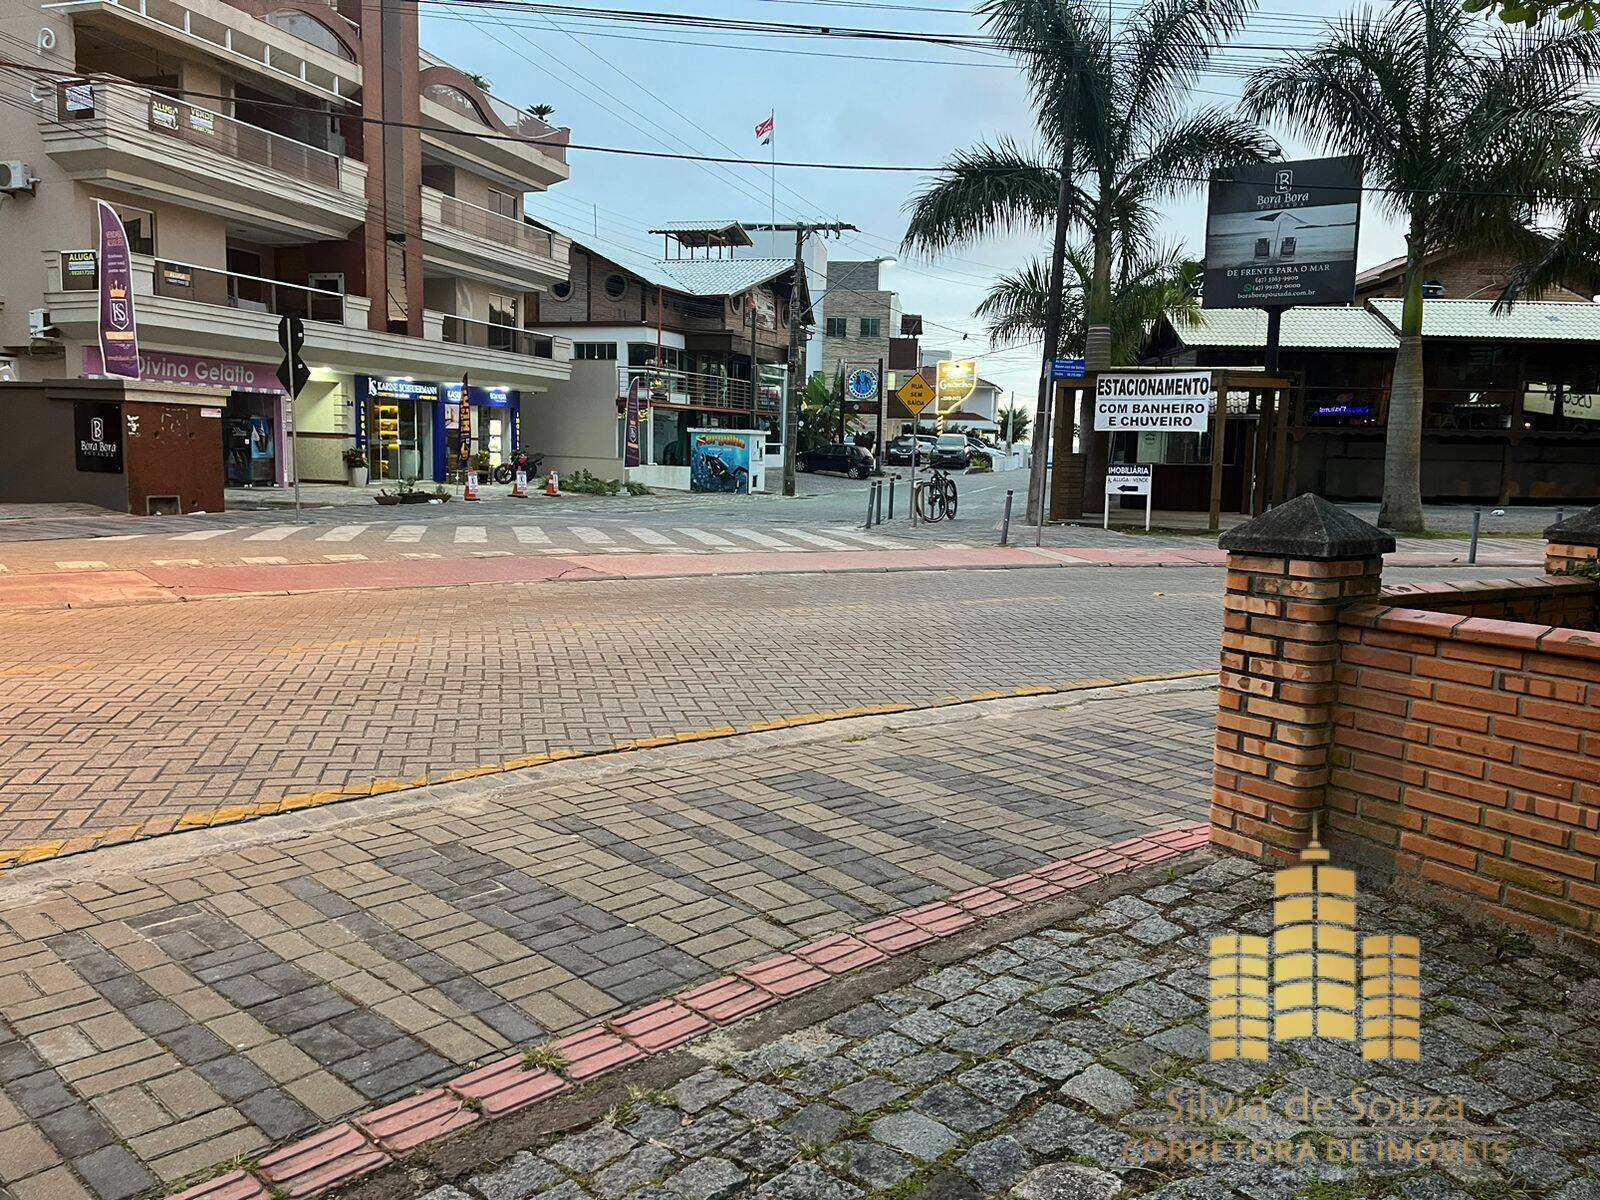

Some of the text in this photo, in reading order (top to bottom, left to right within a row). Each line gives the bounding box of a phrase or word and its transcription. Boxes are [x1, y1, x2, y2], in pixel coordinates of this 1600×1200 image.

[1256, 192, 1309, 205] Bora Bora
[69, 253, 94, 261] ALUGA
[1240, 267, 1274, 276] FRENTE
[1276, 266, 1298, 274] PARA
[1309, 264, 1330, 272] MAR
[138, 356, 255, 384] Divino Gelatto
[1097, 377, 1209, 396] ESTACIONAMENTO
[1098, 404, 1205, 414] COM BANHEIRO
[1109, 416, 1192, 427] E CHUVEIRO
[80, 440, 117, 452] Bora Bora
[1108, 465, 1149, 474] IMOBILIÁRIA
